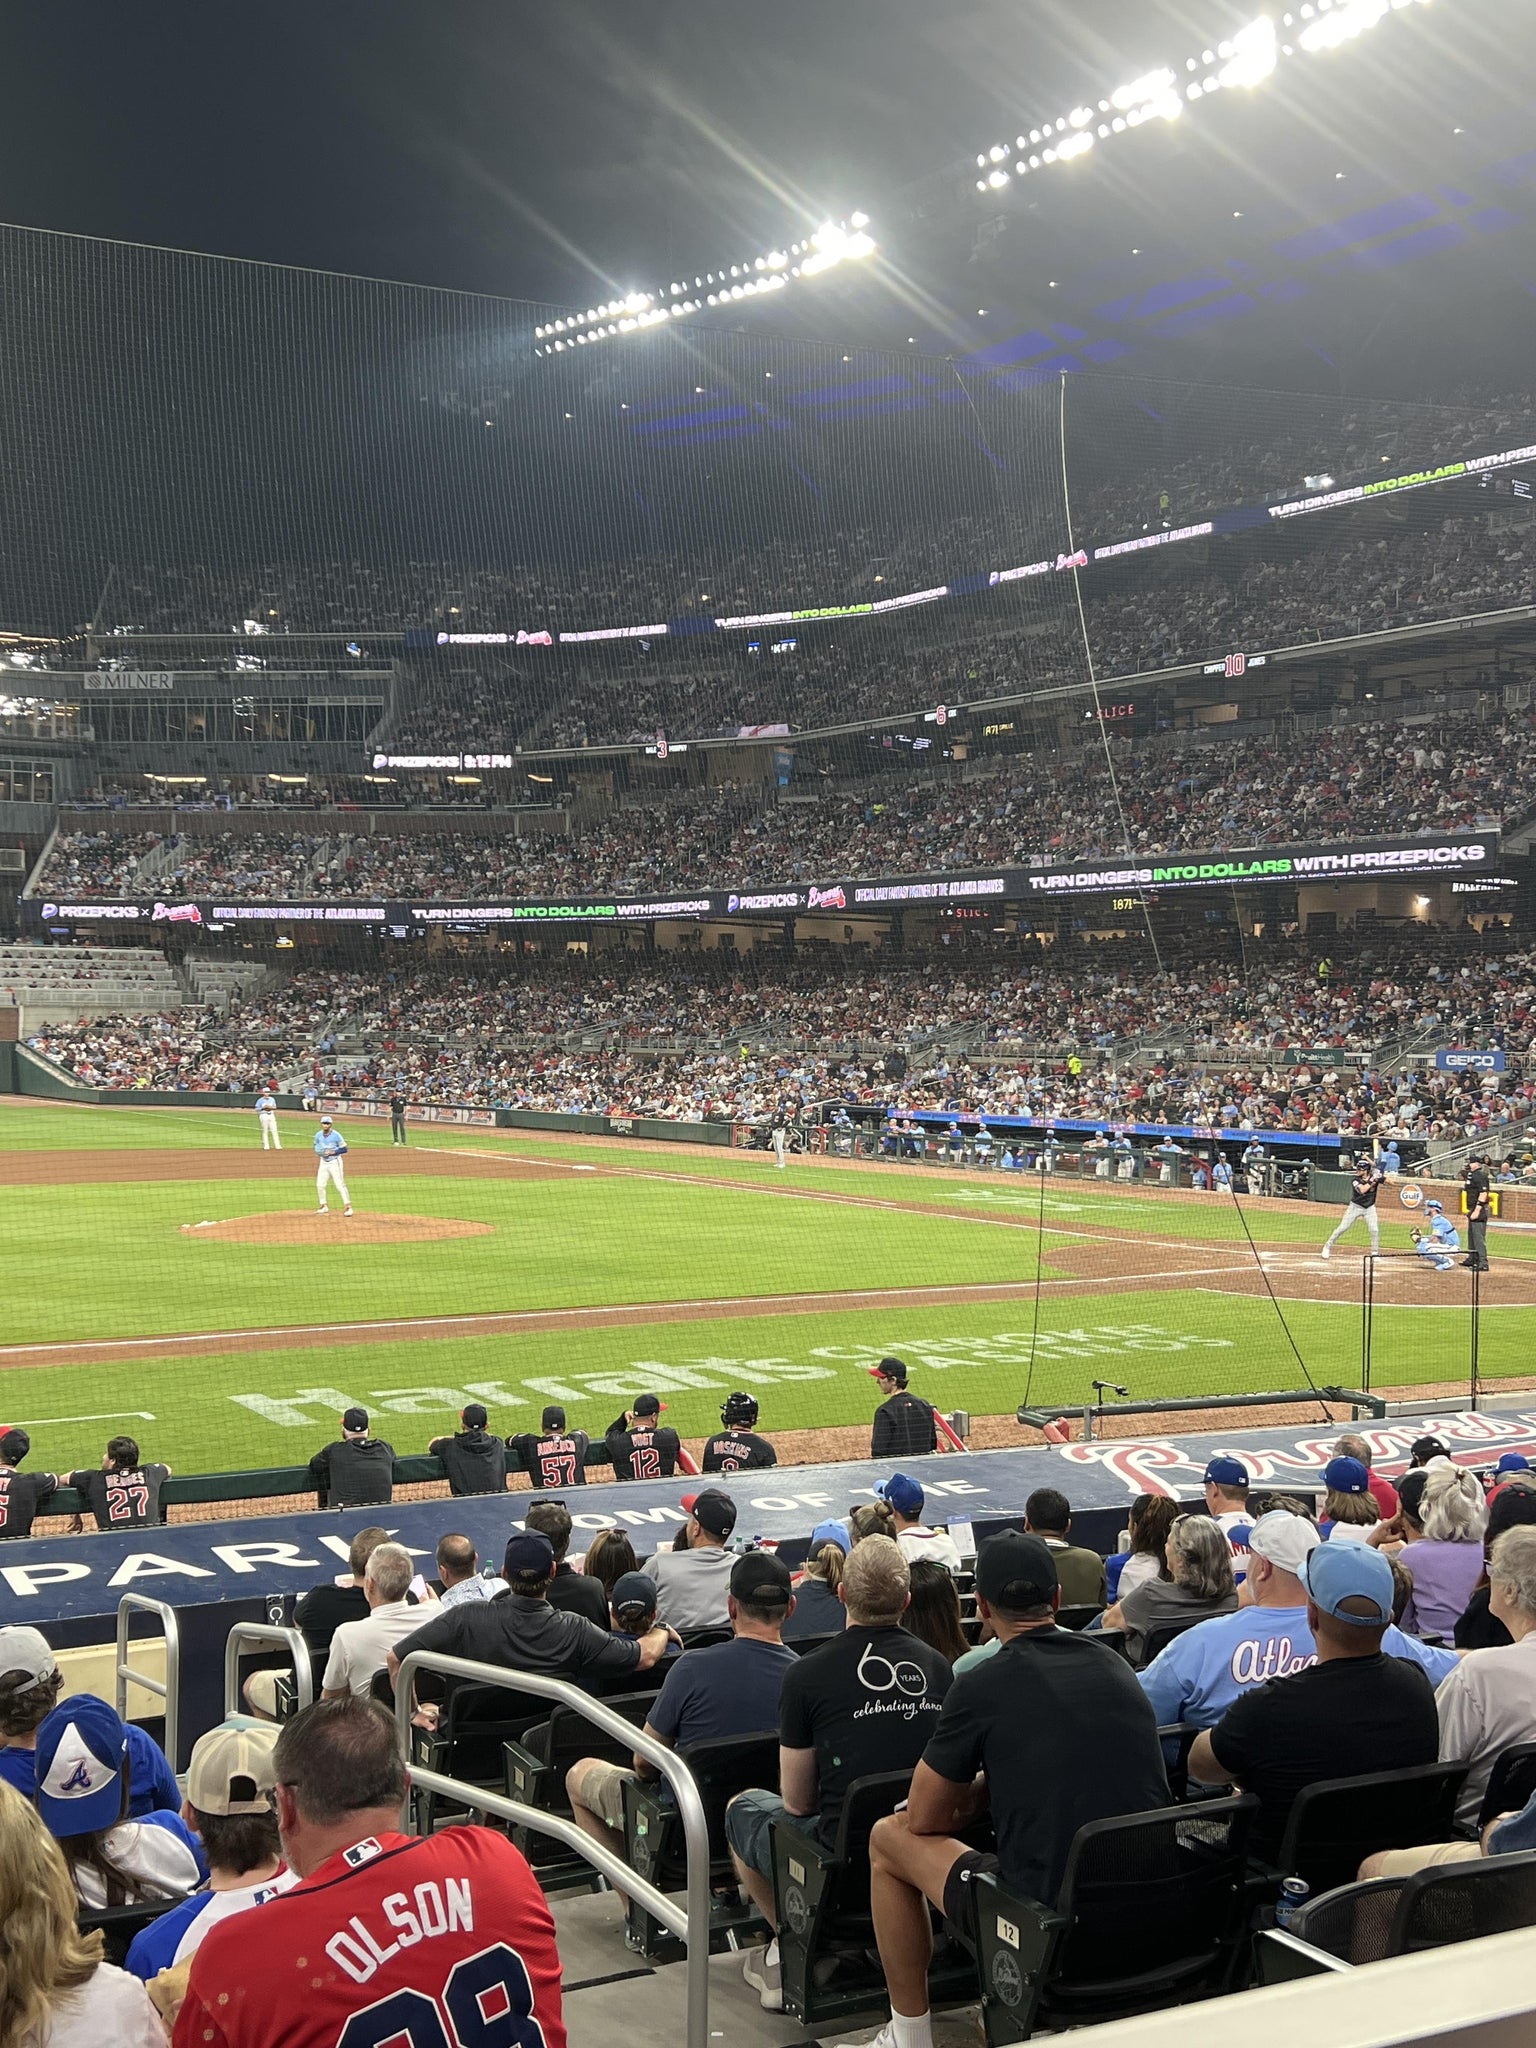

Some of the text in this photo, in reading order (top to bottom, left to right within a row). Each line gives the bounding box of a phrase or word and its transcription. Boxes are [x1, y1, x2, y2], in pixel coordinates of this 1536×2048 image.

[1268, 499, 1305, 517] TURN
[1305, 486, 1363, 508] DINGERS
[1363, 478, 1398, 496] INTO
[1397, 462, 1465, 487] DOLLARS
[1465, 452, 1505, 471] WITH
[792, 609, 820, 619] INTO
[819, 603, 873, 616] DOLLARS
[1225, 652, 1245, 677] 10
[104, 673, 170, 689] MILNER
[936, 705, 946, 725] 6
[656, 741, 668, 759] 3
[1028, 873, 1074, 889] TURN
[1074, 868, 1153, 887] DINGERS
[1153, 865, 1199, 881] INTO
[1199, 858, 1292, 878] DOLLARS
[1292, 854, 1349, 872] WITH
[1350, 844, 1486, 868] PRIZEPICKS
[411, 899, 710, 919] TURN DINGERS INTO DOLLARS WITH PRIZEPICKS
[739, 892, 798, 910] PRIZEPICKS
[58, 905, 139, 918] PRIZEPICKS
[1445, 1055, 1494, 1067] GEICO
[1402, 1192, 1420, 1200] Gulf
[808, 1324, 1170, 1360] CHEROKEE
[541, 1454, 576, 1488] 57
[629, 1447, 661, 1480] 12
[106, 1486, 149, 1521] 27
[750, 1491, 834, 1513] OF
[857, 1642, 929, 1696] 60
[900, 1674, 922, 1682] YEARS
[853, 1699, 919, 1720] celebrating
[325, 1877, 474, 1984] OLSON
[1003, 1922, 1015, 1942] 12
